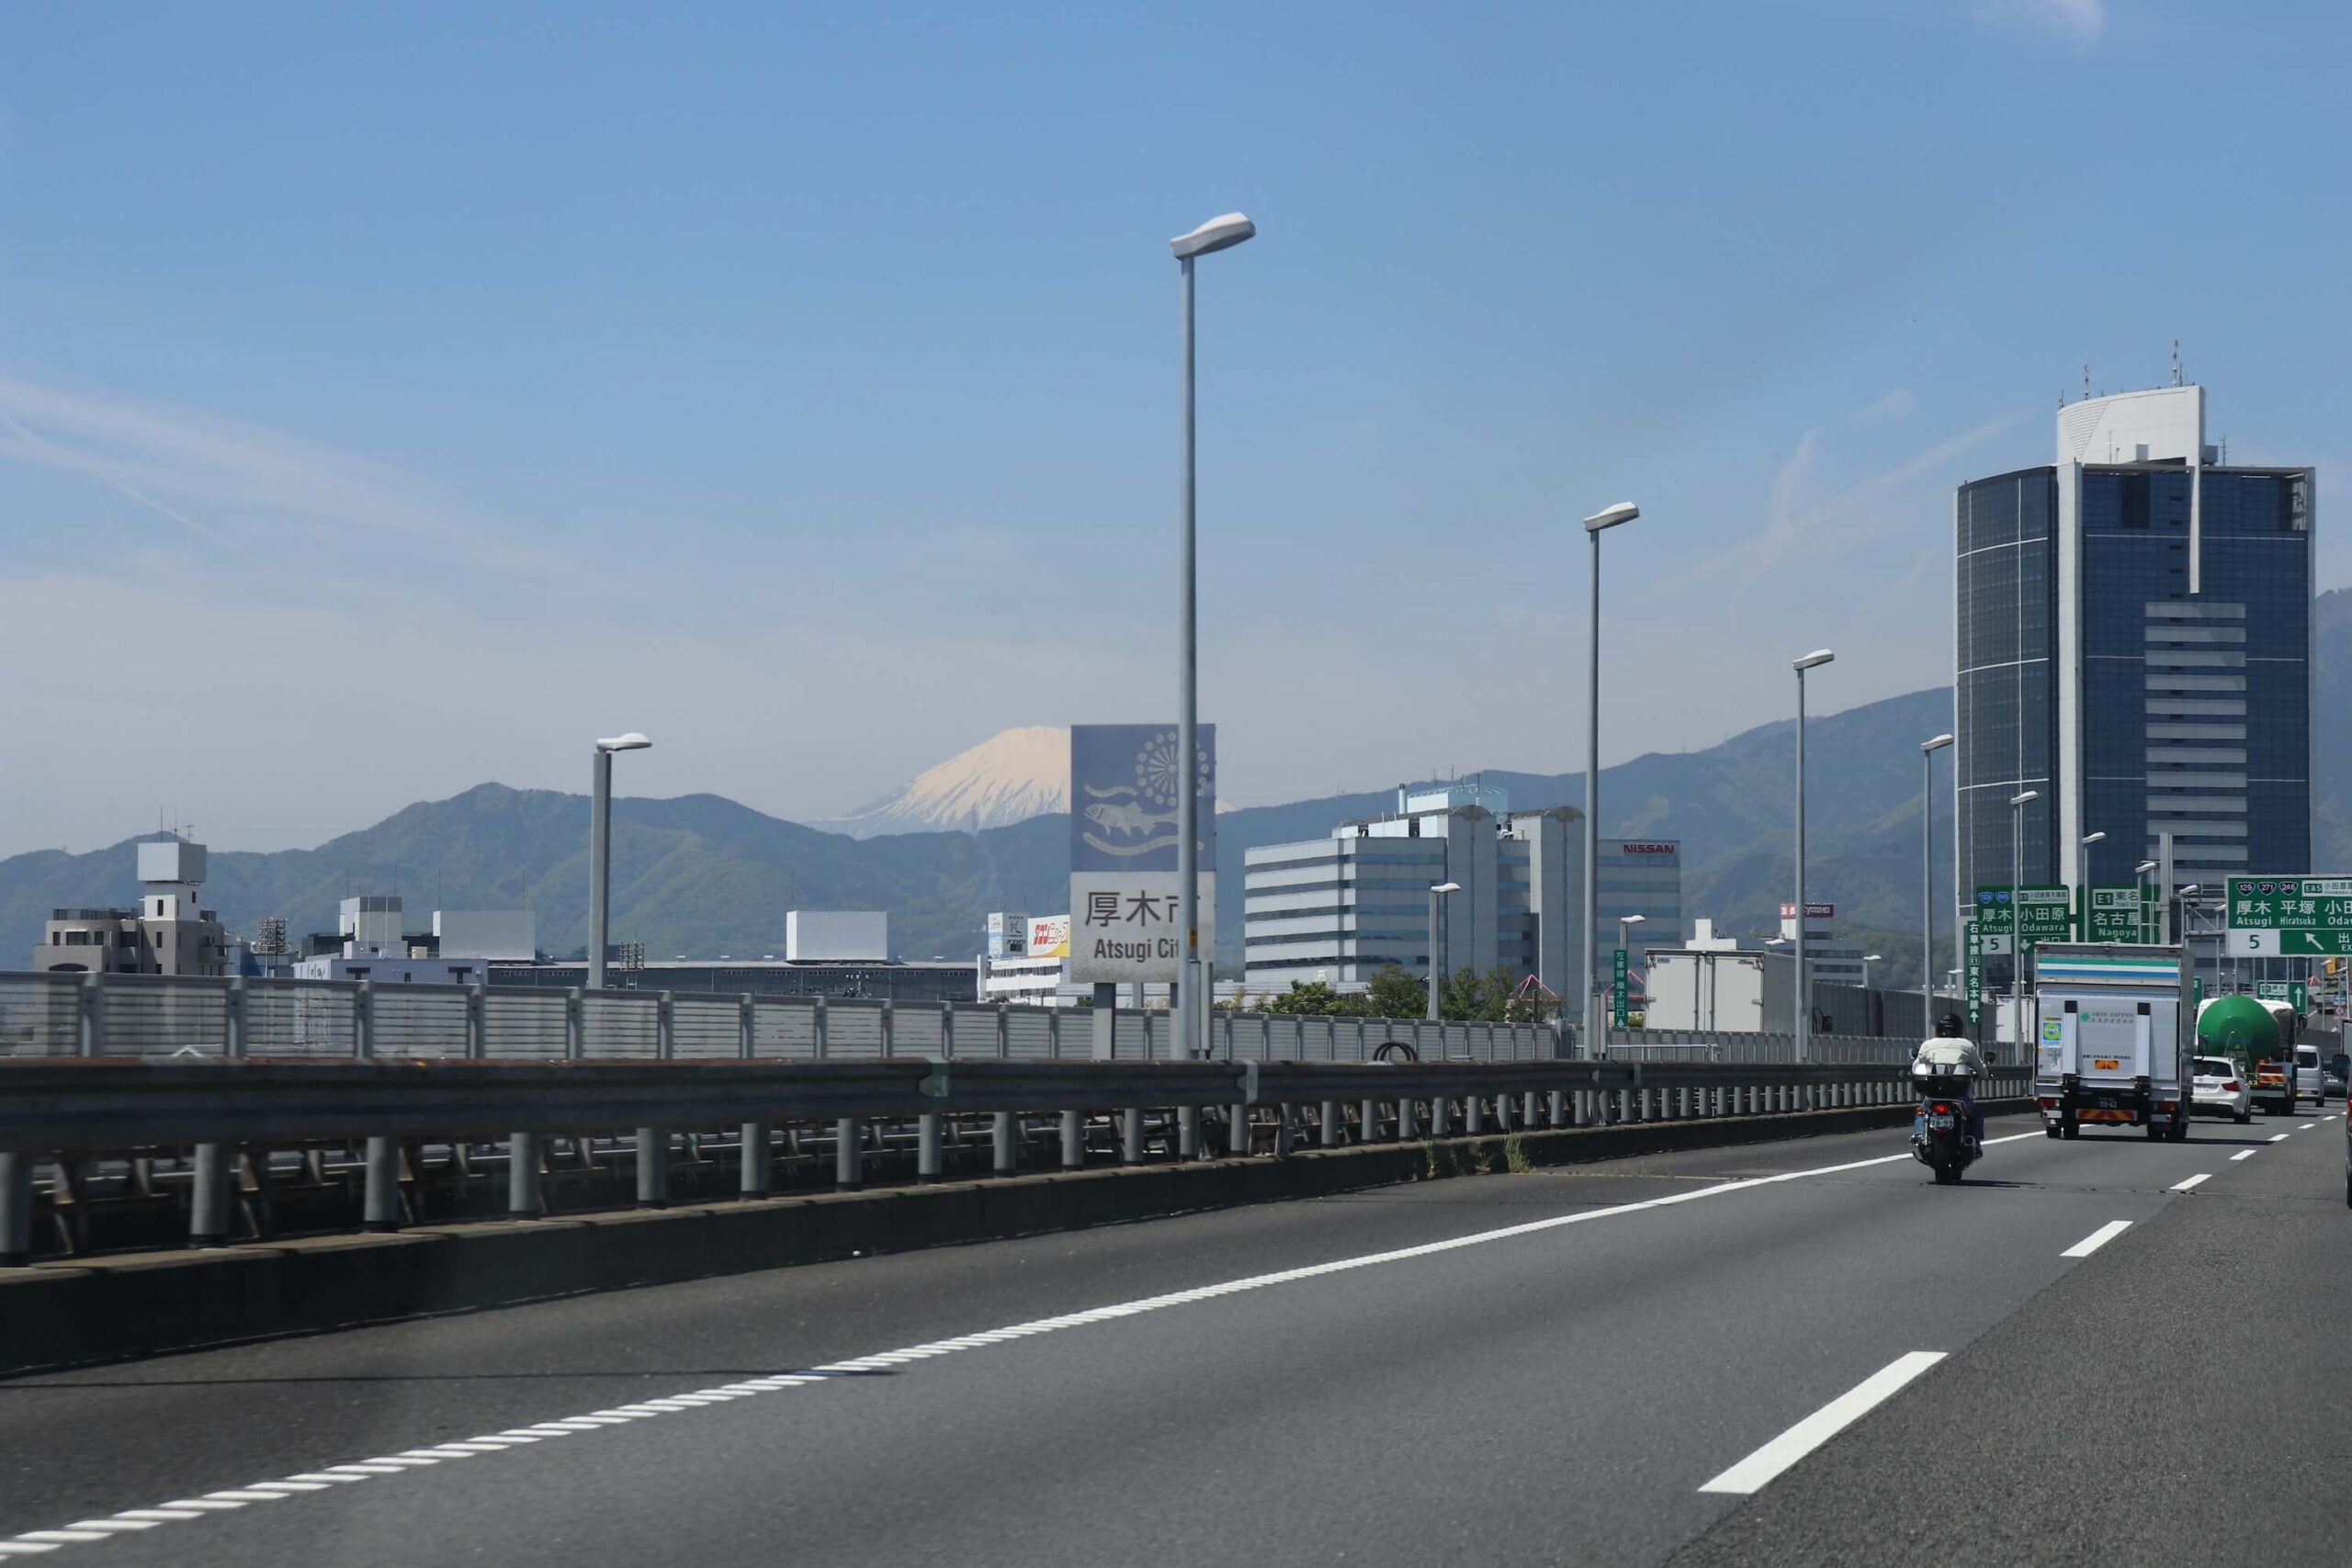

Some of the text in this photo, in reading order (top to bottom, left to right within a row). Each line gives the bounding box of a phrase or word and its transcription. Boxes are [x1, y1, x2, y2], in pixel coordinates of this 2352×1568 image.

[1623, 843, 1674, 853] NISSAN
[2305, 885, 2322, 893] E85
[2097, 894, 2112, 905] E1
[2236, 900, 2272, 915] 厚木
[2280, 900, 2315, 915] 平塚
[1983, 908, 2065, 922] 厚木 小田原
[2093, 912, 2140, 926] 名古屋
[2236, 916, 2272, 927] Atsugi
[2279, 916, 2316, 926] Hiratsuka
[1983, 923, 2065, 934] Atsugi Odawara
[2098, 928, 2138, 939] Nagoya
[1990, 938, 1999, 950] 5
[2249, 935, 2260, 950] 5
[1093, 939, 1152, 963] Atsugi
